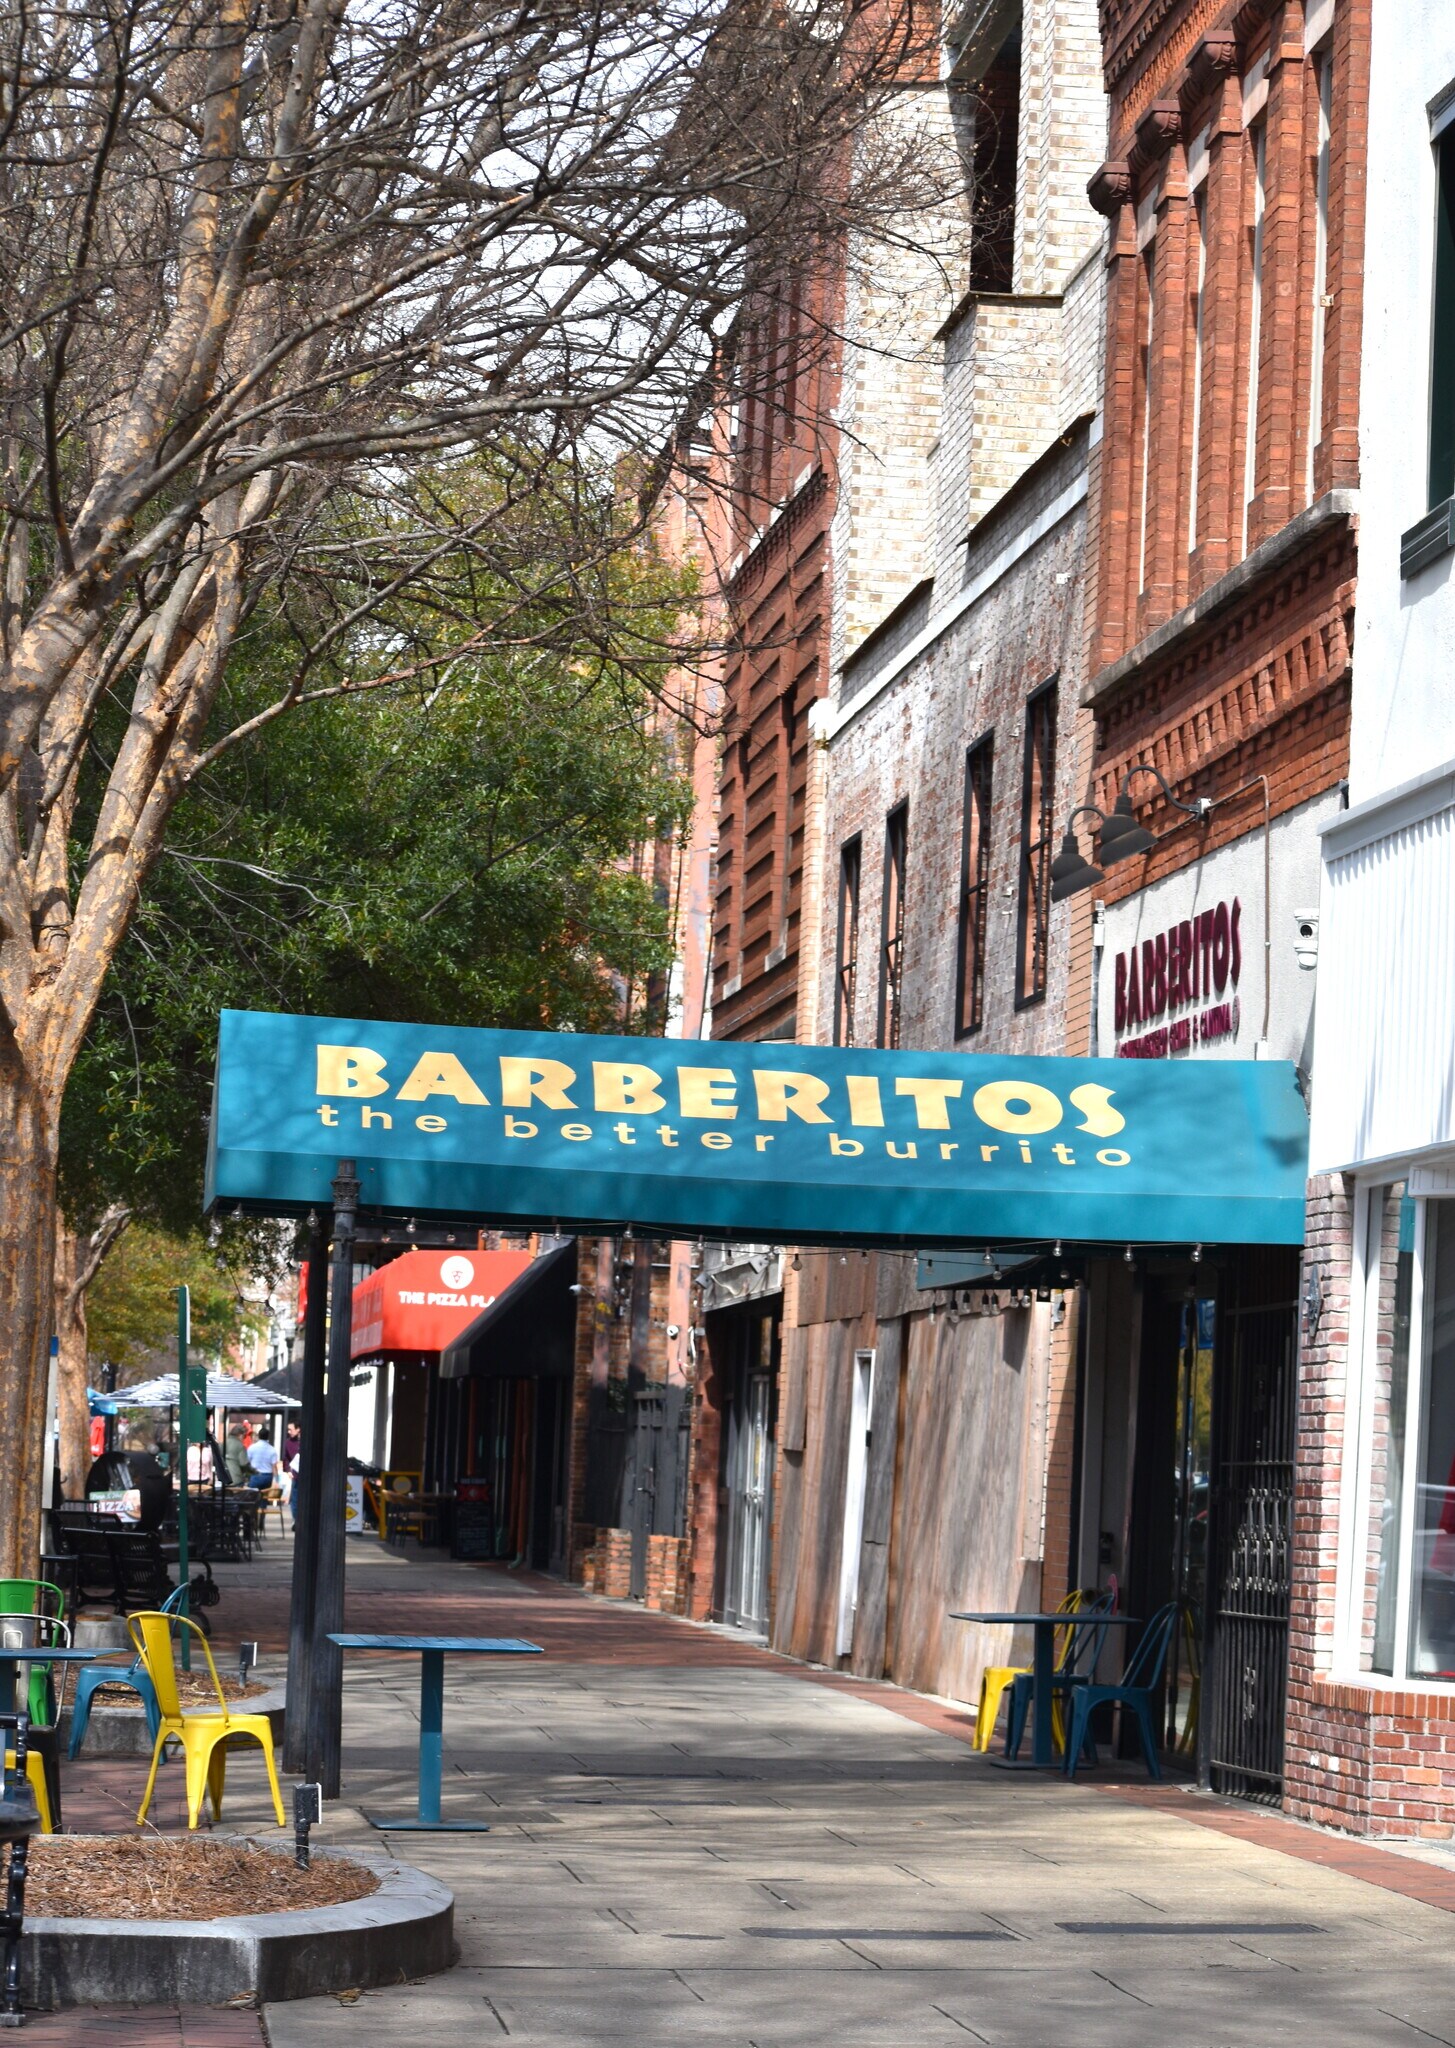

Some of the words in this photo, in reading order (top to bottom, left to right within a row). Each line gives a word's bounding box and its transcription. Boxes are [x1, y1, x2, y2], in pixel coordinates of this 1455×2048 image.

[1115, 896, 1242, 1032] BARBERITOS
[316, 1044, 1126, 1138] BARBERITOS
[316, 1104, 447, 1133] the
[504, 1115, 774, 1152] better
[829, 1133, 1131, 1167] burrito
[398, 1291, 425, 1305] THE
[427, 1292, 469, 1307] PIZZA
